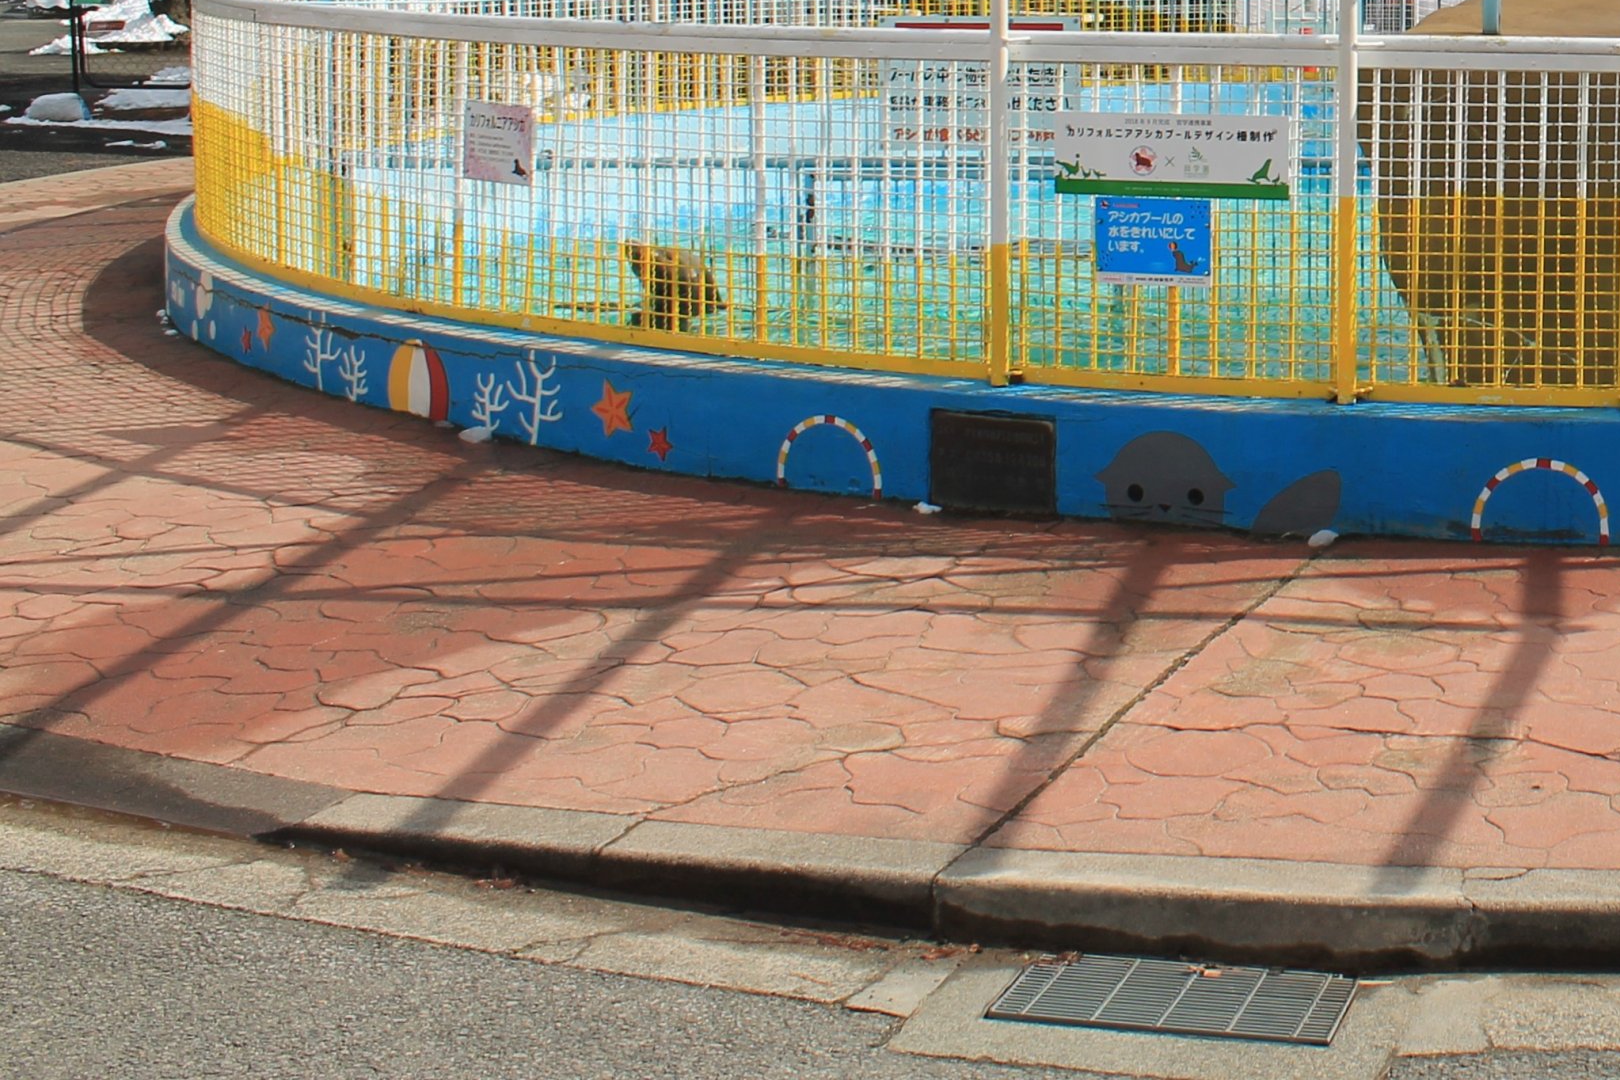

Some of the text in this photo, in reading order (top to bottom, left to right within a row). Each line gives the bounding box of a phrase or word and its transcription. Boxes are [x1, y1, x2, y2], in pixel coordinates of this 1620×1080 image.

[1108, 210, 1184, 224] アシカプールの
[1108, 226, 1196, 240] 水をきれいにして
[1108, 240, 1145, 253] います。
